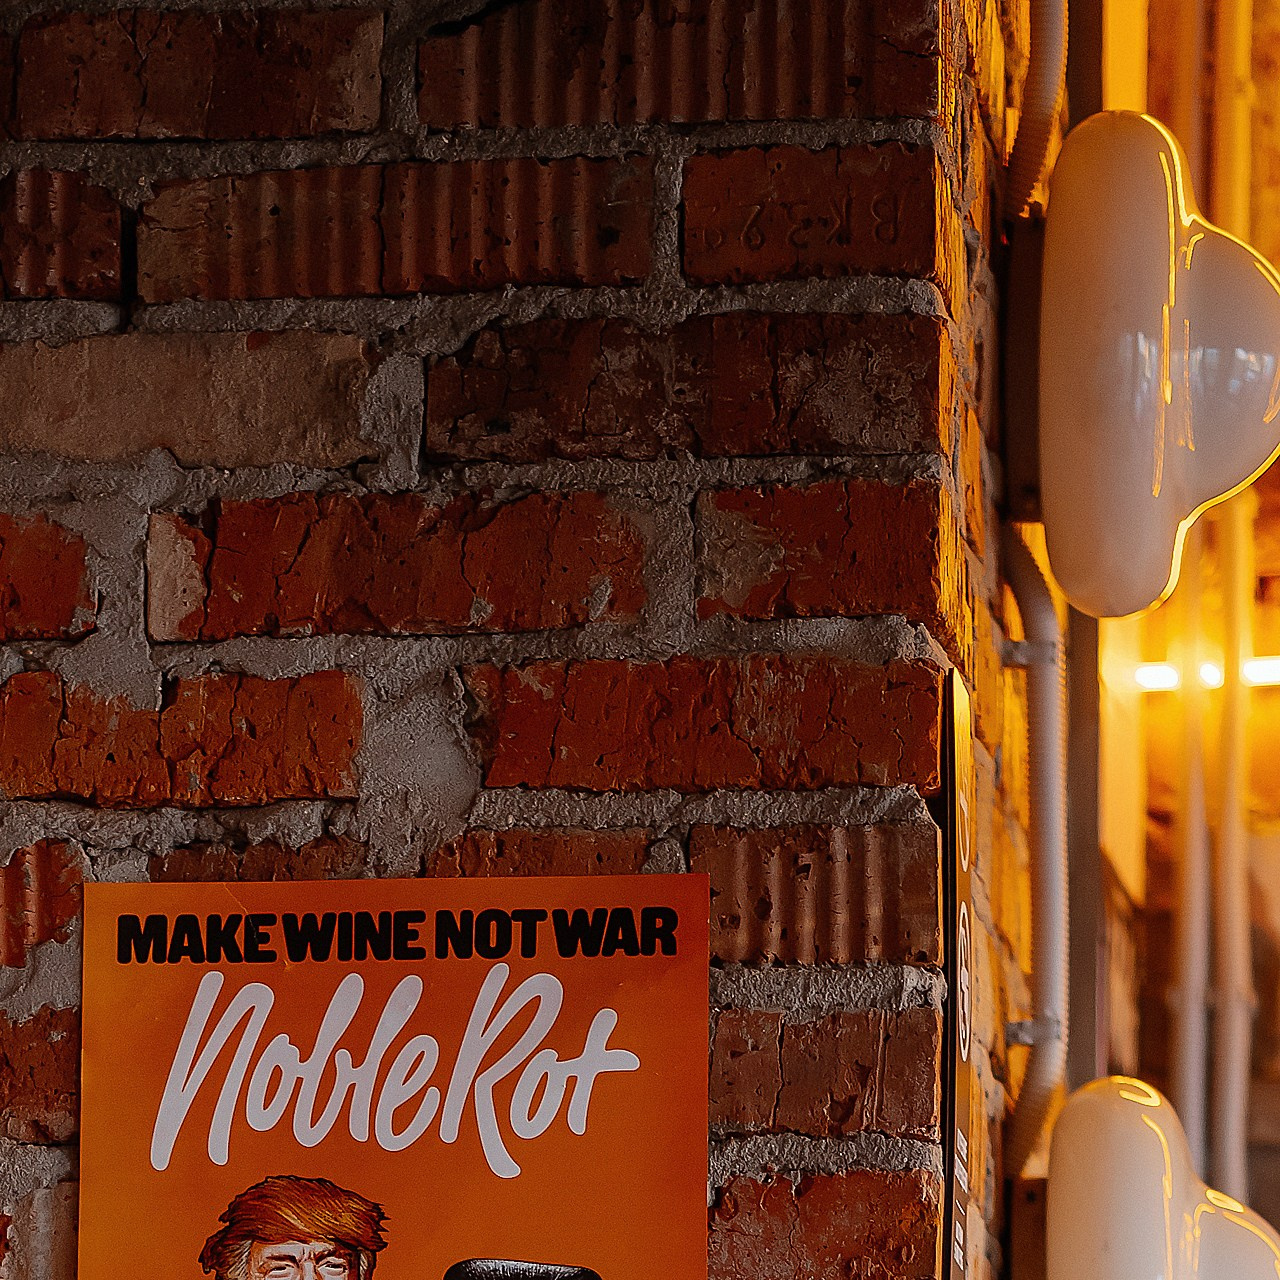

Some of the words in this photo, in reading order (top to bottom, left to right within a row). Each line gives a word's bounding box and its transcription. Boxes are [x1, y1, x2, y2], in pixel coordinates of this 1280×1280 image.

[117, 913, 277, 964] MAKE
[281, 910, 426, 963] WINE
[435, 908, 547, 959] NOT
[550, 906, 679, 957] WAR
[439, 963, 640, 1179] Rot
